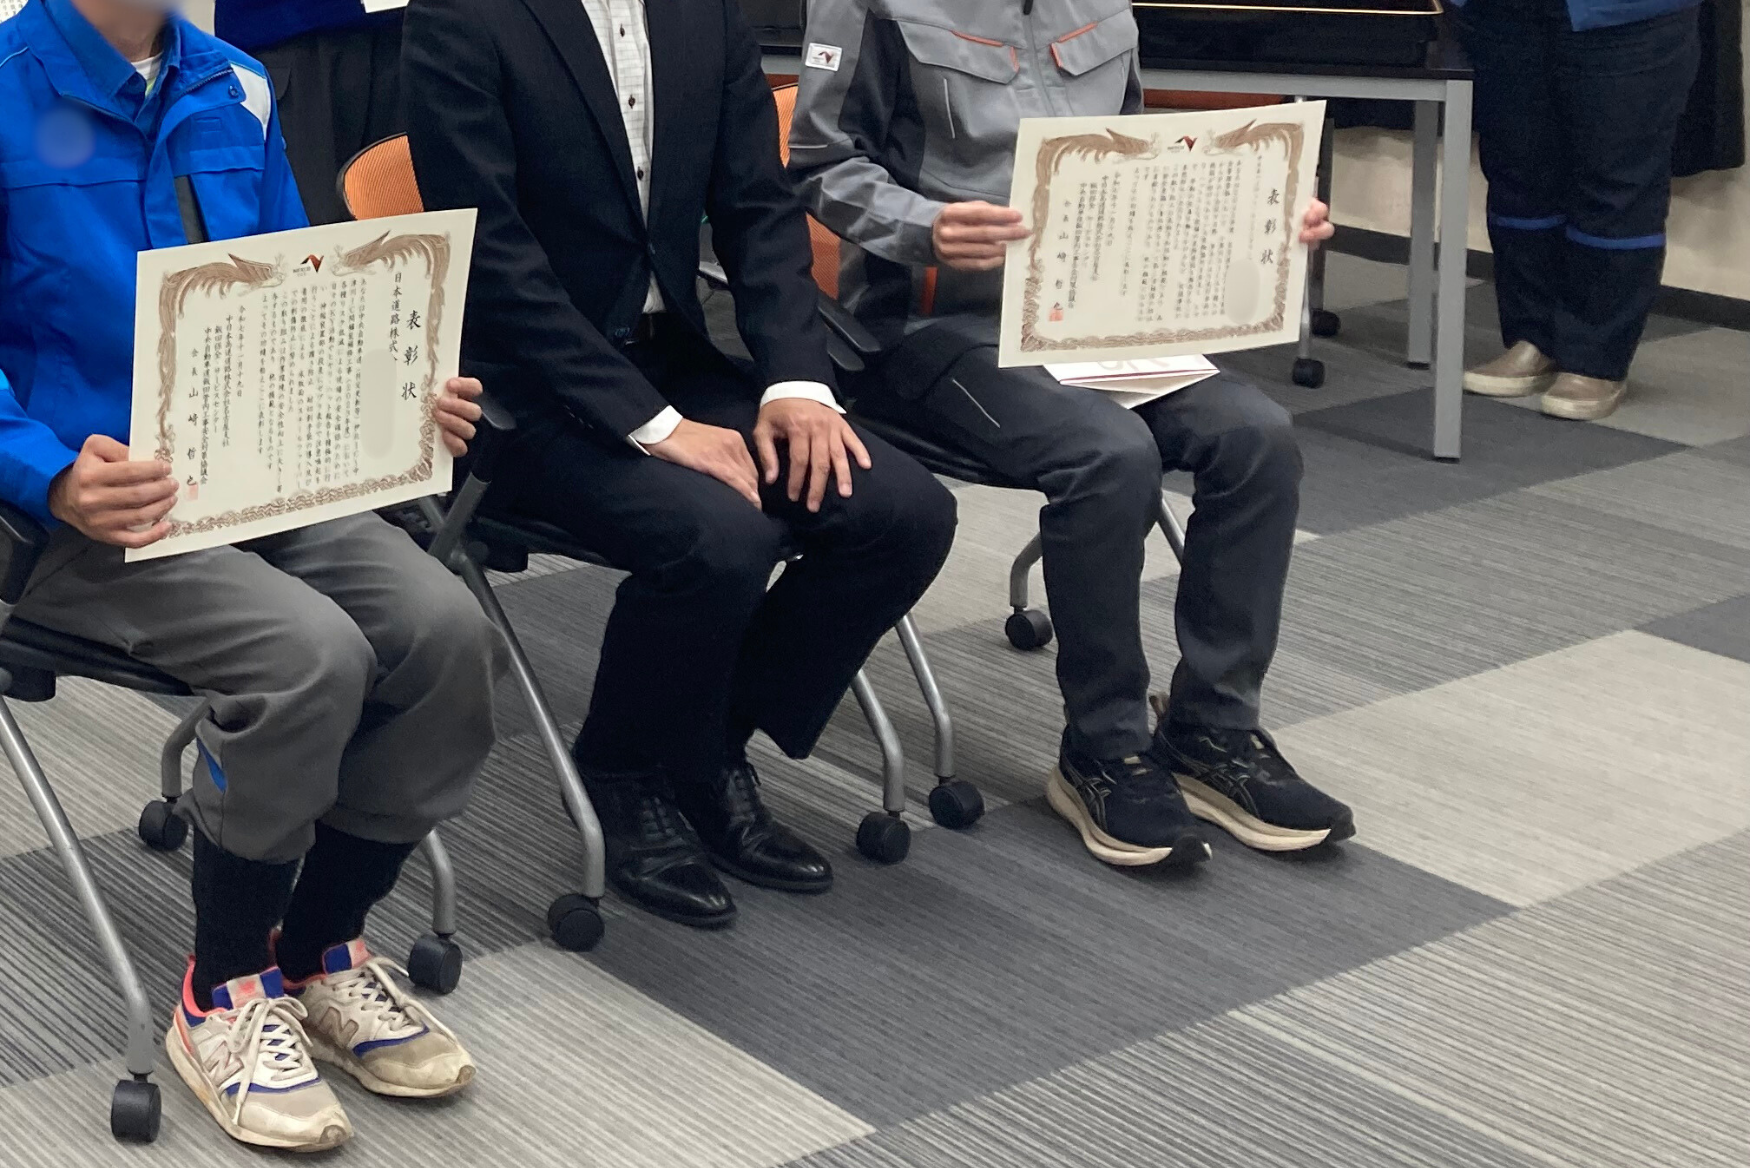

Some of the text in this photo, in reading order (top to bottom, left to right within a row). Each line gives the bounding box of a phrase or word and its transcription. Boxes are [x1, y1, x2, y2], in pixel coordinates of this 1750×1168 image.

[1261, 187, 1280, 265] 表彰状
[389, 272, 402, 361] 日本道路株式
[401, 309, 421, 401] 表彰状
